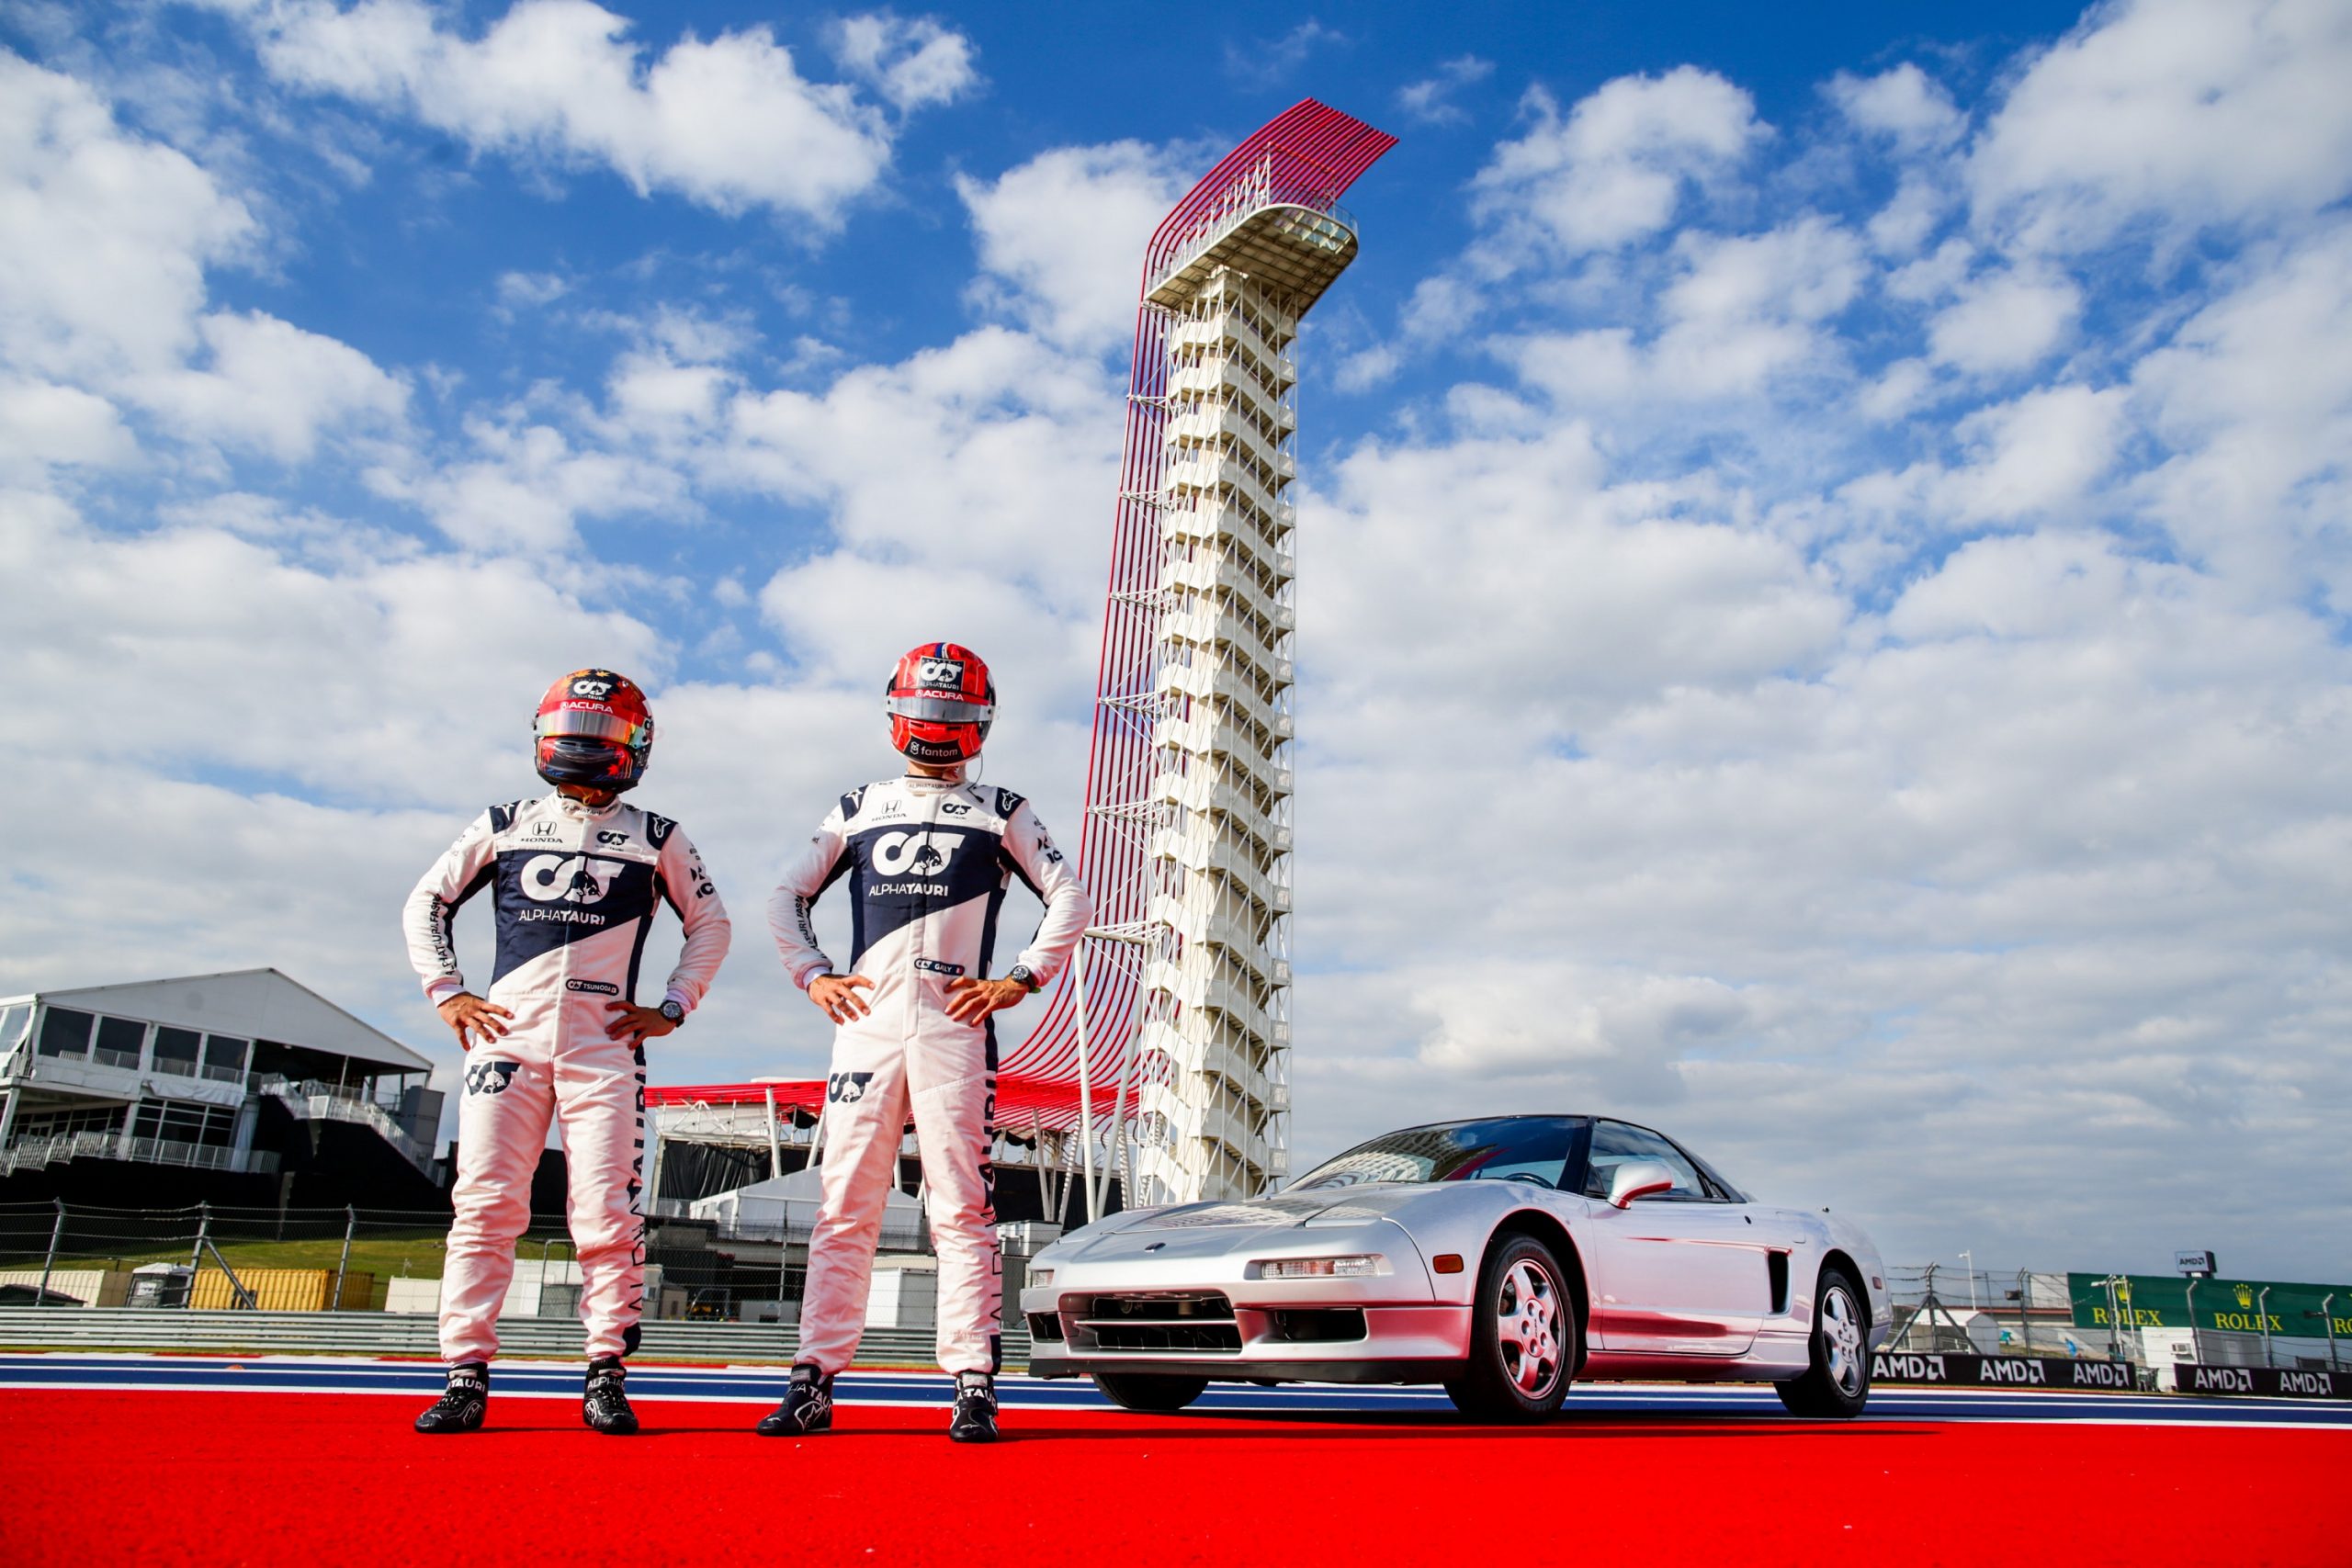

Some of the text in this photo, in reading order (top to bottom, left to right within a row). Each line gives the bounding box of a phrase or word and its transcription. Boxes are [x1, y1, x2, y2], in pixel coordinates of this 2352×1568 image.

[920, 681, 960, 691] ALPHATAURI
[922, 690, 964, 701] ACURA
[569, 701, 614, 714] ACURA
[921, 746, 958, 757] fantom
[872, 813, 908, 821] HONDA
[868, 883, 949, 897] ALPHATAURI
[519, 908, 605, 926] ALPHATAURI
[2093, 1307, 2163, 1326] ROLEX
[2214, 1313, 2283, 1331] ROLEX
[1871, 1355, 1926, 1380] AMD
[1980, 1359, 2027, 1383] AMD
[2074, 1362, 2113, 1385] AMD
[2195, 1368, 2238, 1391] AMD
[2280, 1371, 2317, 1393] AMD
